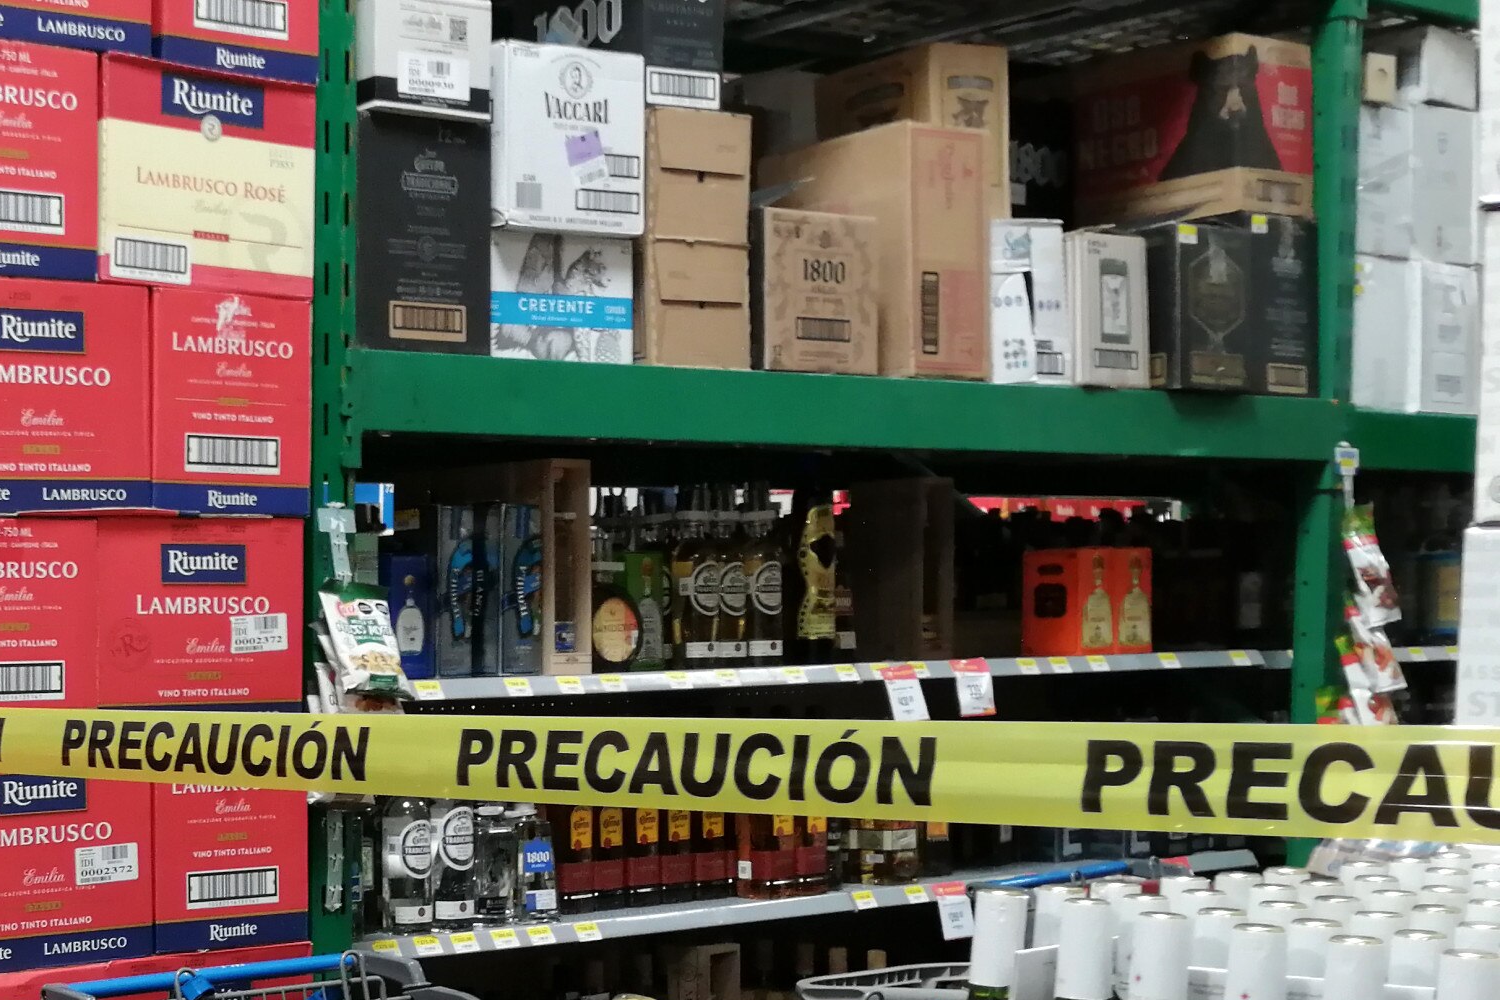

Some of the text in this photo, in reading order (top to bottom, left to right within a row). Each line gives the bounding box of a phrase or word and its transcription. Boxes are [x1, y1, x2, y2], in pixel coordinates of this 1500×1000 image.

[37, 17, 126, 42] LAMBRUSCO
[215, 47, 265, 70] Riunite
[172, 78, 253, 117] Riunite
[544, 91, 609, 124] VACCARI
[18, 167, 57, 180] ITALIANO
[136, 166, 286, 204] LAMBRUSCO ROSÉ
[803, 259, 845, 284] 1800
[518, 297, 596, 314] CREYENTE
[0, 314, 76, 342] Riunite
[172, 332, 294, 360] LAMBRUSCO
[18, 463, 46, 472] TINTO
[48, 463, 91, 472] ITALIANO
[42, 487, 127, 501] LAMBRUSCO
[207, 490, 258, 508] Riunite
[168, 550, 239, 576] Riunite
[136, 594, 270, 616] LAMBRUSCO
[19, 638, 58, 648] ITALIANO
[186, 638, 226, 654] Emilia
[234, 635, 283, 647] 0002372
[158, 687, 250, 698] VINO TINTO ITALIANO
[61, 713, 371, 782] PRECAUCIÓN
[456, 729, 938, 807] PRECAUCIÓN
[3, 780, 78, 807] Riunite
[215, 798, 252, 815] Emilia
[192, 846, 272, 859] VINO TINTO ITALIANO
[527, 851, 549, 863] 1800
[22, 868, 66, 887] Emilia
[80, 864, 133, 878] 0002372
[20, 918, 48, 931] TINTO
[50, 915, 92, 928] ITALIANO
[209, 922, 258, 941] Riunite
[43, 936, 128, 956] LAMBRUSCO
